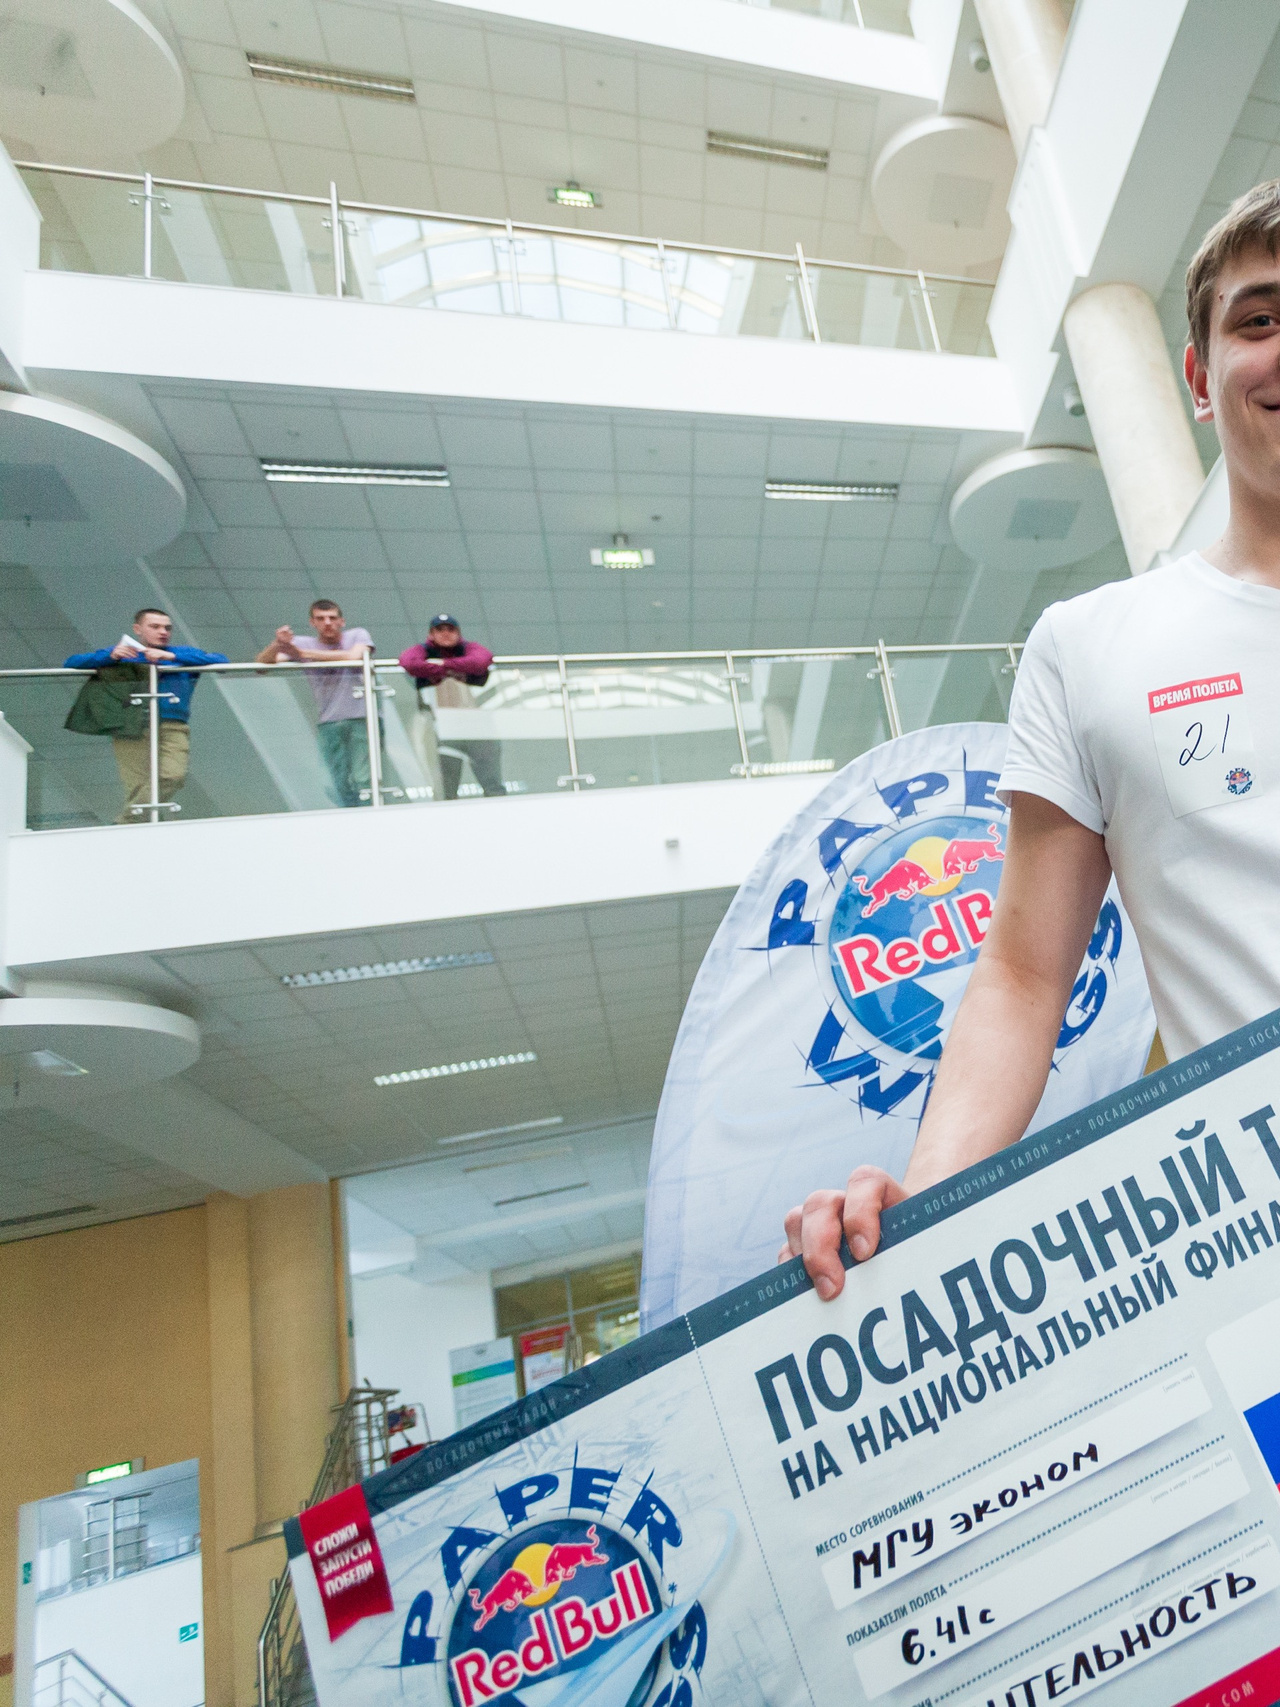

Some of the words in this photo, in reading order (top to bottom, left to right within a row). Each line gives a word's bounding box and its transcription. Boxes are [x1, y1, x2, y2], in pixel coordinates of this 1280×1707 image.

[1153, 687, 1191, 708] ВРЕМЯ
[1192, 678, 1238, 698] ПОЛЕТА
[1178, 713, 1230, 767] 21
[766, 766, 1012, 952] PAPE
[833, 901, 961, 999] Red
[1088, 1080, 1169, 1132] ПОСАДОЧНЫЙ
[1172, 1059, 1212, 1089] ТАЛОН
[924, 1164, 1006, 1216] ПОСАДОЧНЫЙ
[1009, 1143, 1050, 1172] ТАЛОН
[755, 1118, 1247, 1445] ПОСАДОЧНЫЙ
[757, 1269, 806, 1302] ПОСАДО
[780, 1438, 843, 1500] НА
[847, 1251, 1179, 1464] НАЦИОНАЛЬНЫЙ
[314, 1522, 359, 1556] СЛОЖИ
[321, 1538, 372, 1578] ЗАПУСТИ
[815, 1532, 847, 1557] МЕСТО
[850, 1491, 925, 1538] СОРЕВНОВАНИЯ
[853, 1518, 934, 1589] МГУ
[325, 1560, 374, 1599] ПОБЕДИ
[397, 1460, 684, 1668] PAPER
[451, 1609, 555, 1707] Red
[551, 1559, 654, 1659] Bull
[846, 1607, 908, 1647] ПОКАЗАТЕЛИ
[909, 1584, 947, 1613] ПОЛЕТА
